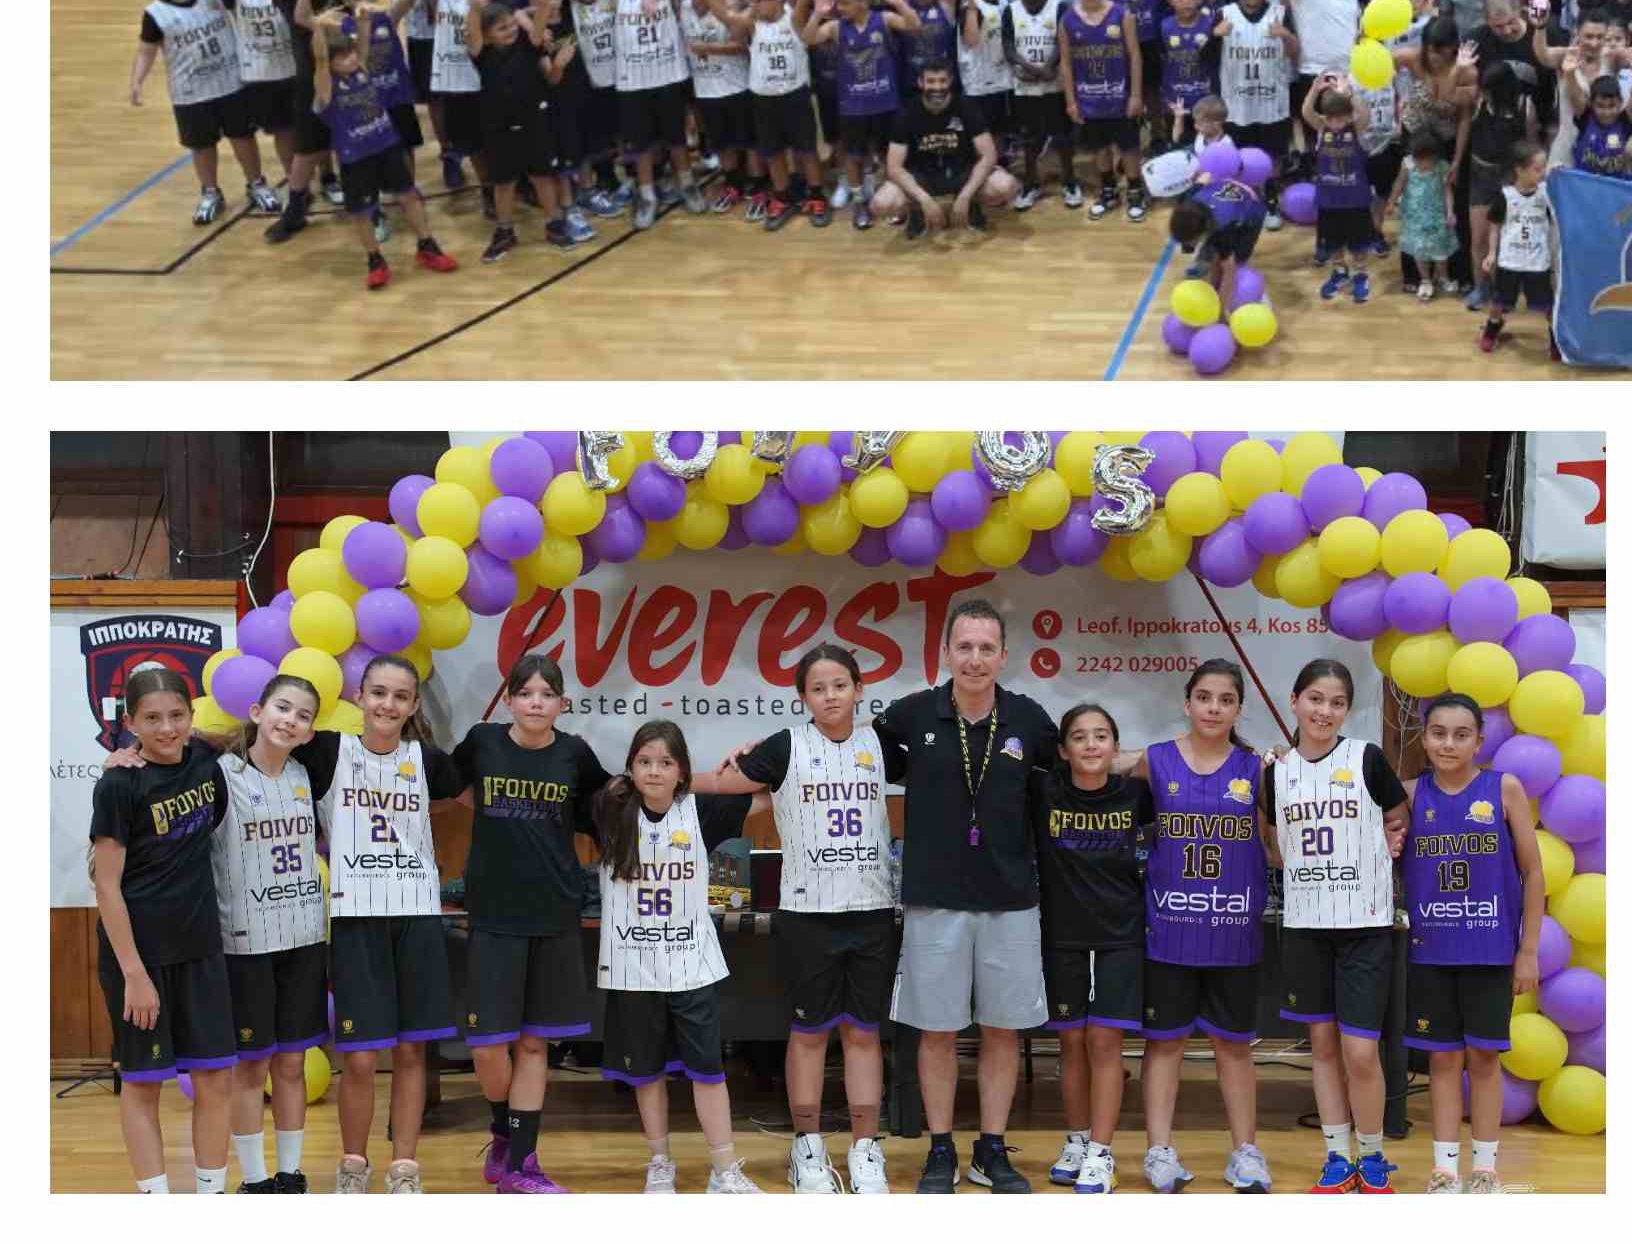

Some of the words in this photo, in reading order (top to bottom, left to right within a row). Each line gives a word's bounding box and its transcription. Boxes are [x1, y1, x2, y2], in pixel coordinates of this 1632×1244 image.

[88, 619, 214, 647] ΙΠΠΟΚΡΑΤΗΣ
[497, 564, 999, 688] everest
[1077, 616, 1122, 635] Leof.
[1247, 617, 1262, 637] 4,
[1268, 617, 1300, 635] Kos
[1076, 656, 1123, 673] 2242
[1128, 656, 1199, 673] 029005
[342, 788, 420, 812] FOIVOS
[492, 779, 569, 803] FOIVOS
[801, 781, 880, 804] FOIVOS
[827, 808, 863, 838] 36
[1062, 810, 1132, 831] FOIVOS
[1283, 799, 1358, 825] FOIVOS
[244, 816, 313, 842] FOIVOS
[1158, 813, 1253, 841] FOIVOS
[1302, 826, 1334, 857] 20
[1415, 834, 1498, 858] FOIVOS
[271, 843, 302, 875] 35
[1183, 843, 1222, 880] 16
[1289, 860, 1359, 883] vestal
[1437, 860, 1471, 892] 19
[251, 878, 321, 904] vestal
[1153, 886, 1250, 913] vestal
[1328, 883, 1361, 893] group
[637, 887, 673, 917] 56
[1419, 895, 1498, 918] vestal
[617, 920, 694, 943] vestal
[1211, 915, 1250, 927] group
[1466, 918, 1499, 929] group
[664, 943, 696, 954] group
